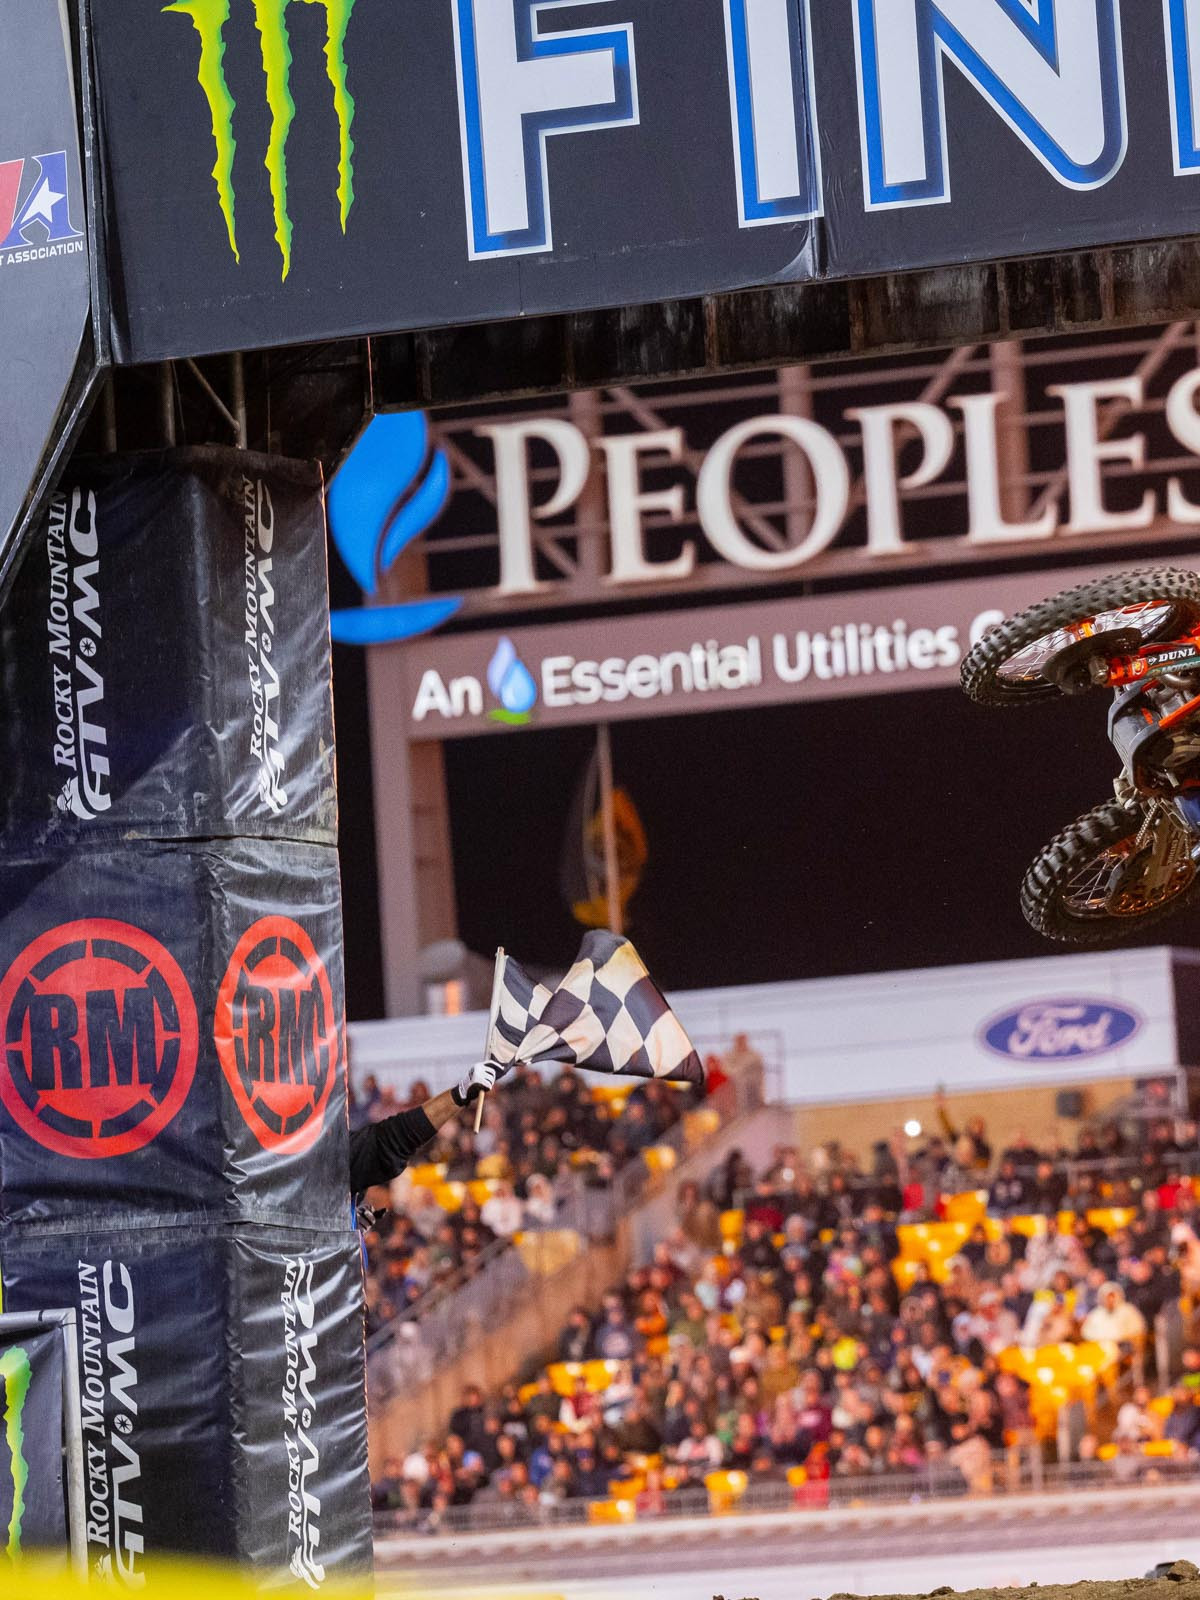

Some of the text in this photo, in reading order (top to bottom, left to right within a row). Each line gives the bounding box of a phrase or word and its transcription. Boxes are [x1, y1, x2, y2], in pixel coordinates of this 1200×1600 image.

[6, 240, 84, 265] ASSOCIATION
[48, 488, 77, 772] ROCKY MOUNTAIN
[242, 474, 265, 762] ROCKY MOUNTAIN
[412, 669, 484, 721] An
[541, 634, 763, 706] Essential
[772, 618, 961, 684] Utilities
[29, 987, 157, 1090] RM
[243, 984, 321, 1091] RM
[1007, 1004, 1111, 1056] Ford
[77, 1259, 111, 1548] ROCKY MOUNTAIN
[280, 1254, 305, 1540] ROCKY MOUNTAIN
